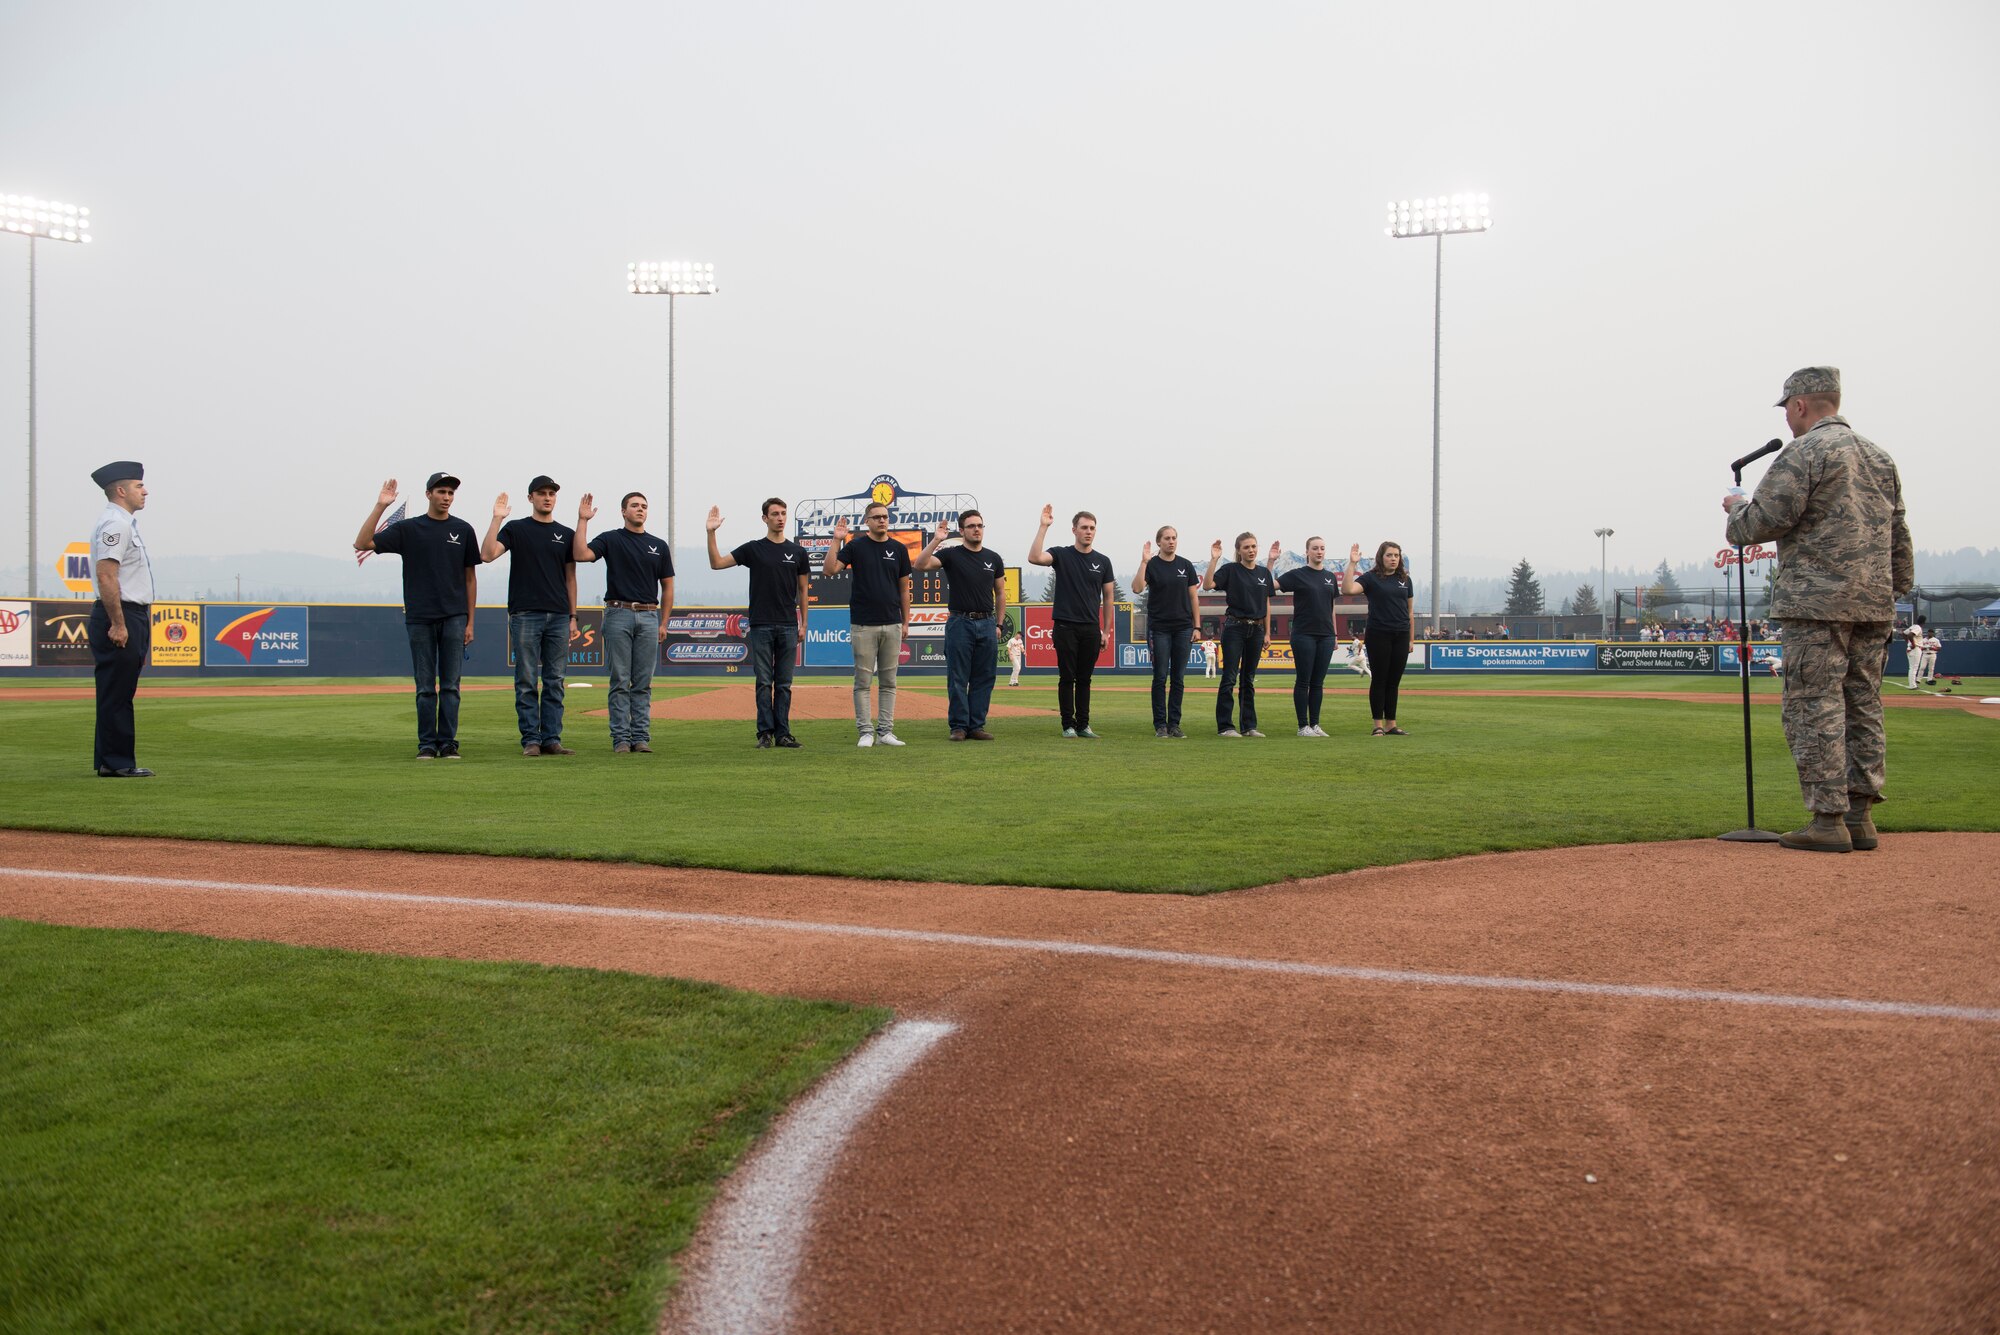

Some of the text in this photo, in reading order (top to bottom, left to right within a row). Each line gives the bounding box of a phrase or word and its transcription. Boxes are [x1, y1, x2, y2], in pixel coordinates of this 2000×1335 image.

[871, 476, 898, 488] SPOKANE
[803, 509, 866, 527] AVIST
[67, 556, 92, 579] NA
[923, 579, 930, 590] 0
[934, 579, 941, 590] 0
[923, 592, 930, 603] 0
[934, 592, 941, 603] 0
[152, 608, 199, 626] MILLER
[669, 620, 693, 628] HOUSE
[694, 620, 704, 628] OF
[242, 632, 299, 640] BANNER
[808, 629, 852, 643] MultiCa
[1027, 625, 1053, 639] Gre
[261, 641, 299, 650] BANK
[673, 645, 743, 653] AIR ELECTRIC
[920, 653, 946, 661] coordina
[1438, 646, 1590, 657] THE SPOKESMAN-REVIEW
[1615, 648, 1694, 660] Complete Heating
[1753, 648, 1778, 656] KANE
[1482, 658, 1545, 666] spokesman.com
